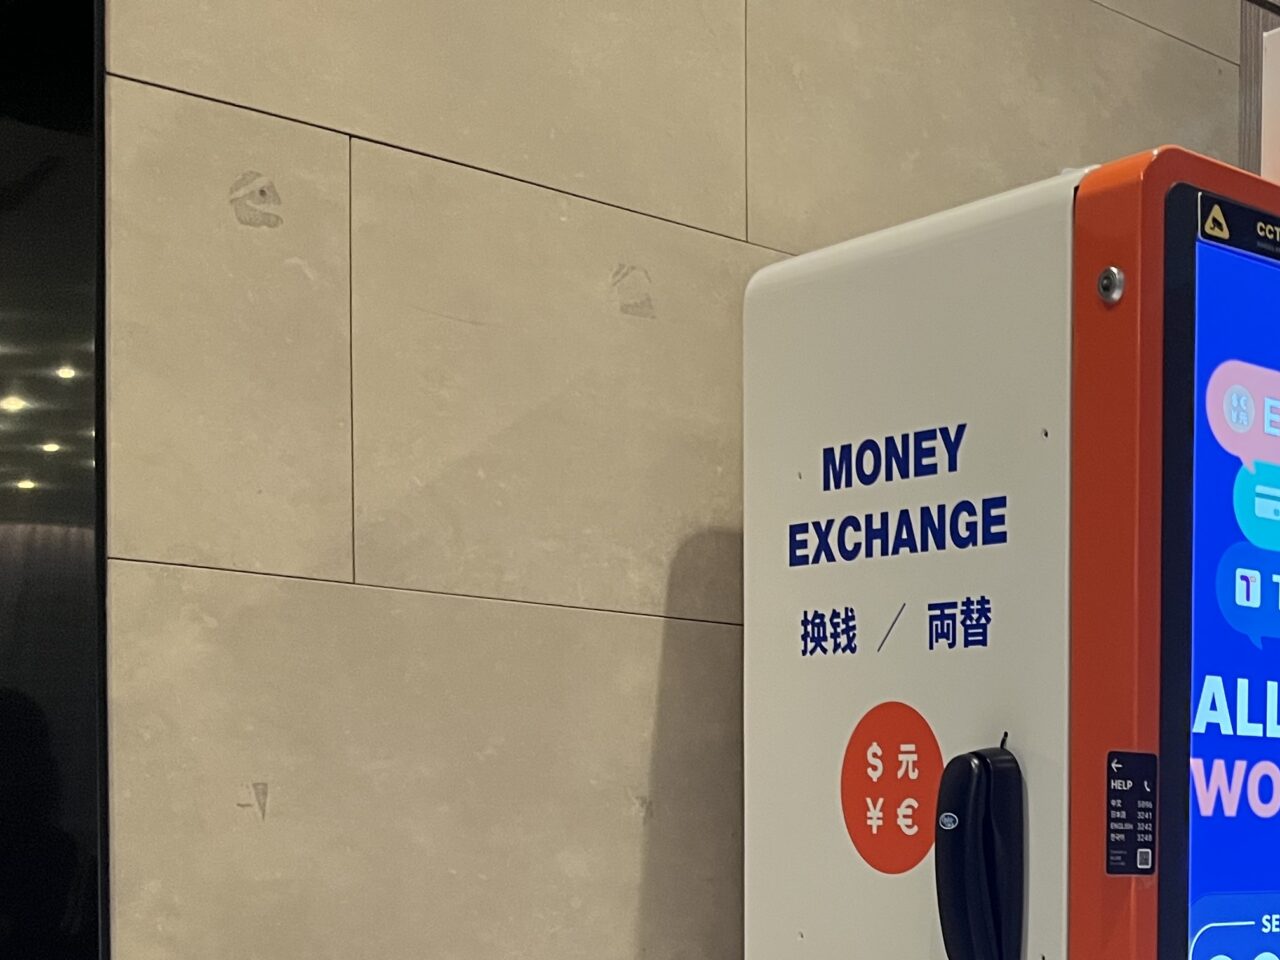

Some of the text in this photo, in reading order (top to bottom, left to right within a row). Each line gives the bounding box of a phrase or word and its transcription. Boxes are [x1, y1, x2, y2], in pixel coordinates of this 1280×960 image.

[822, 423, 967, 491] MONEY
[788, 496, 1008, 567] EXCHANGE
[801, 606, 857, 656] 换钱
[928, 595, 993, 650] 両替
[1111, 779, 1133, 790] HELP
